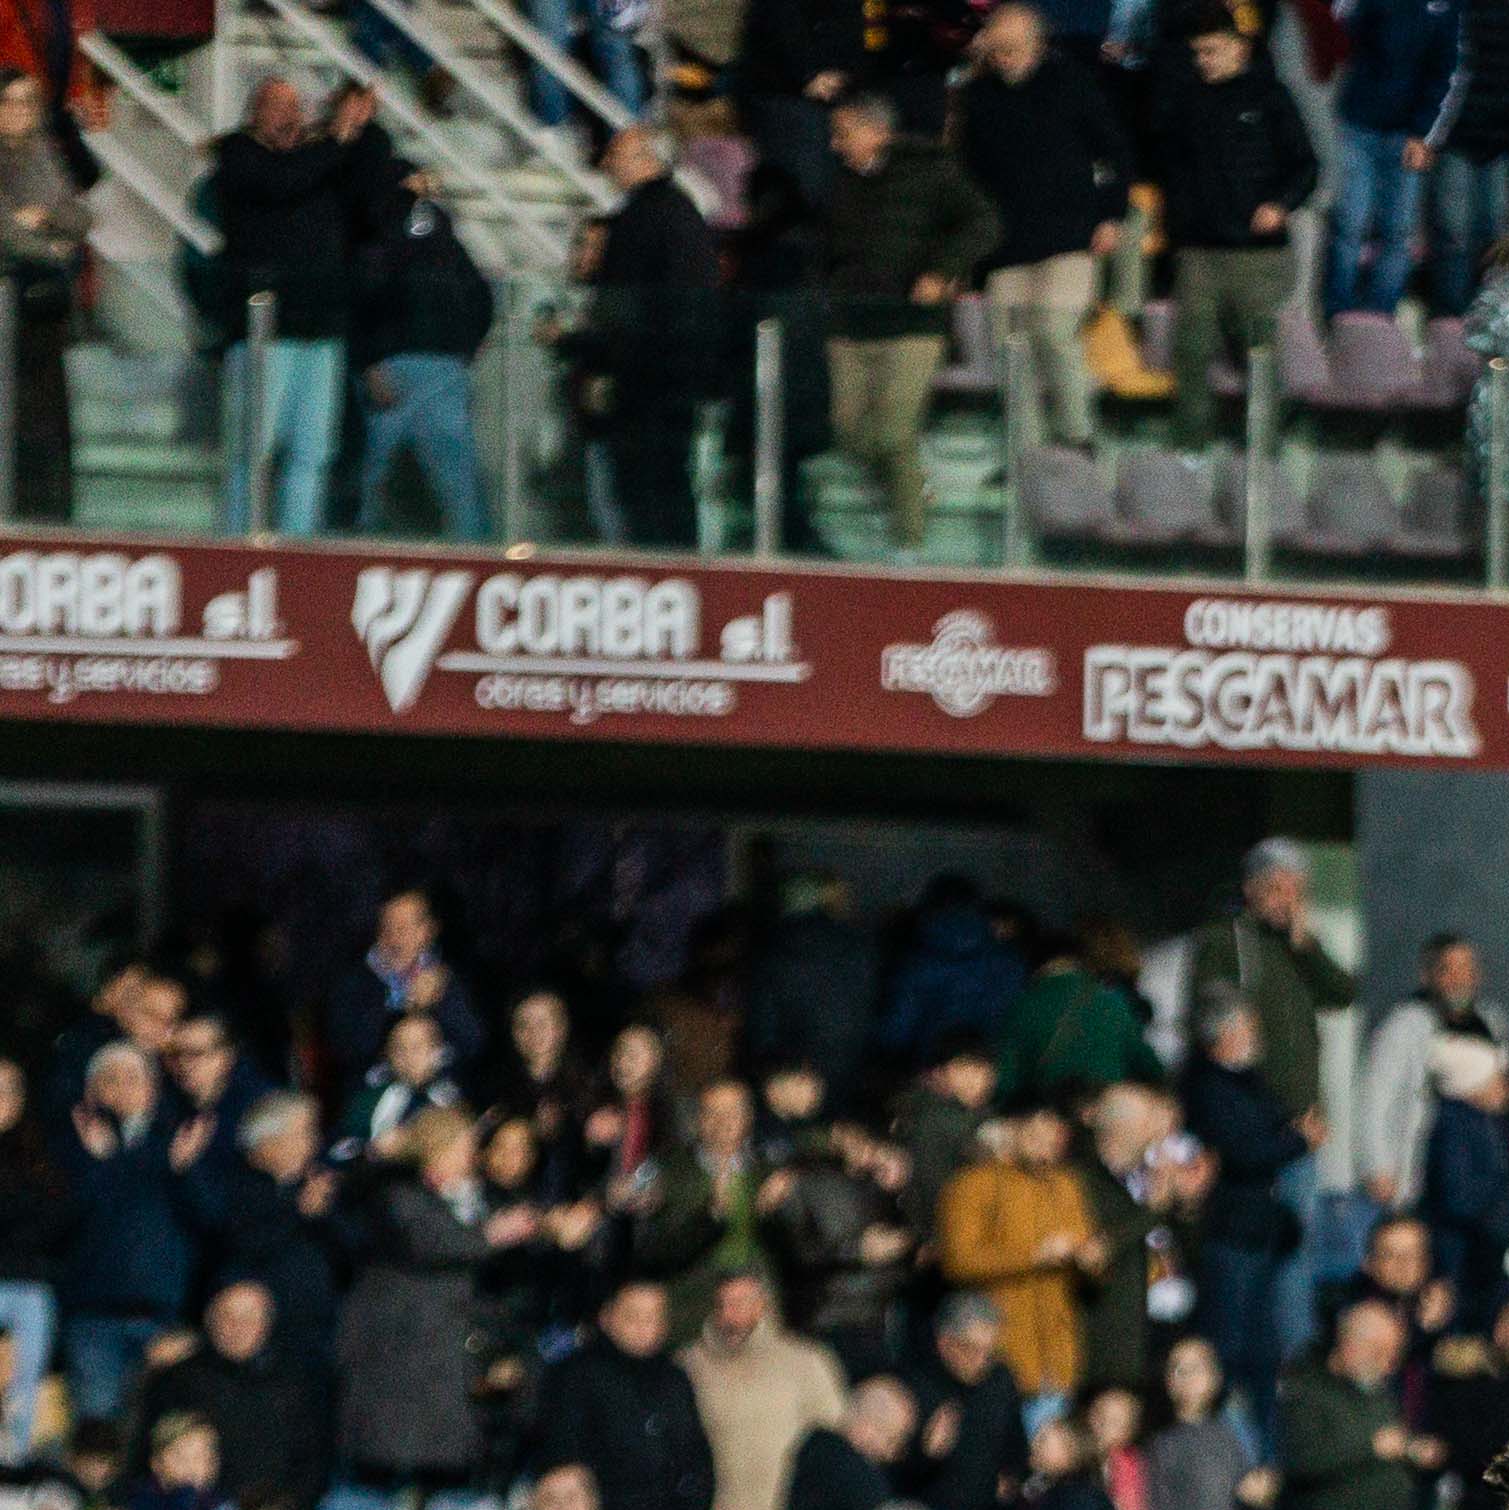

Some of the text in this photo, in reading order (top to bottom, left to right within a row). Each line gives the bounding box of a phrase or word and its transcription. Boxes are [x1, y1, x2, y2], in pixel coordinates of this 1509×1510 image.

[0, 550, 182, 638] ORBA
[476, 573, 702, 659] CORBA
[1185, 601, 1390, 656] CONSERVAS
[1083, 646, 1482, 758] PESCAMAR
